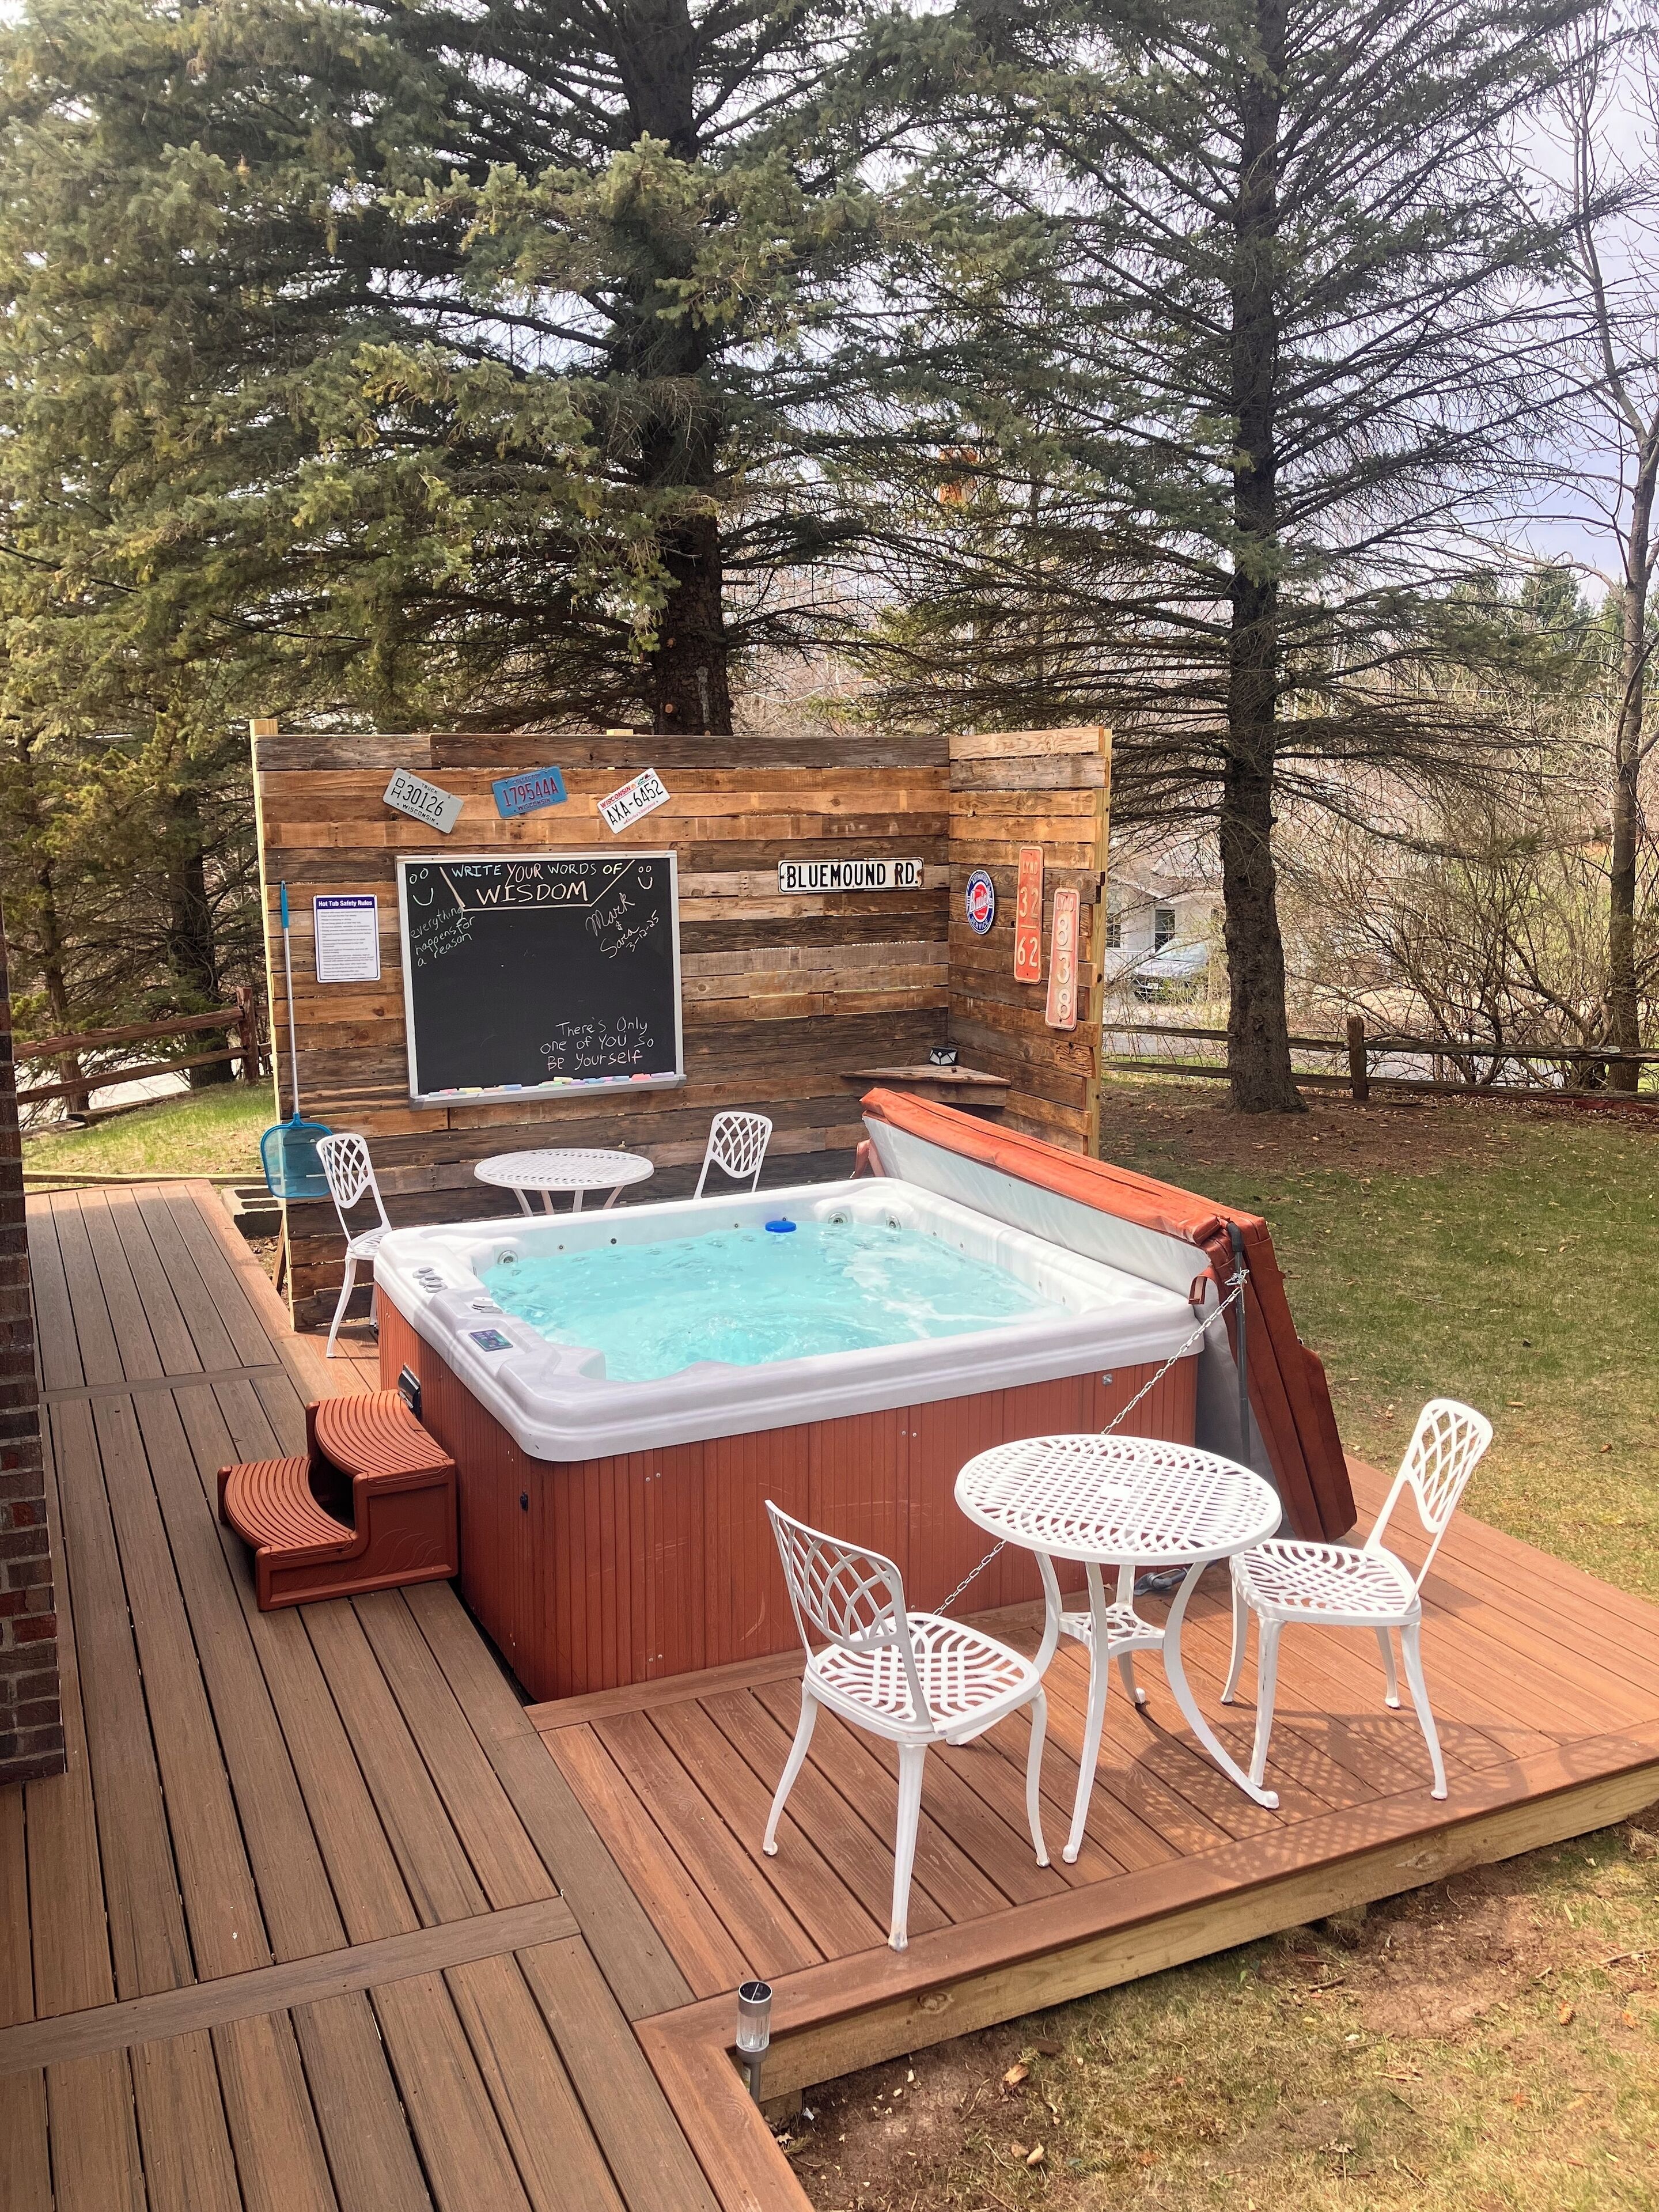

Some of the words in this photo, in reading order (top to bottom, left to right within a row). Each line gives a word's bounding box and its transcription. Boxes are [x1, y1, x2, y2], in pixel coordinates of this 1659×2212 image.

[403, 784, 444, 816] 30126
[422, 783, 437, 794] TRUCK
[503, 777, 559, 807] 179544A
[600, 785, 631, 808] WISCONSIN
[403, 803, 436, 822] WISCONSIN
[517, 798, 551, 810] WISCONSIN
[607, 779, 664, 825] AXA-6452
[452, 864, 502, 877] WRITE
[505, 863, 544, 887] YOUR
[547, 862, 597, 876] WORDS
[603, 862, 623, 875] OF
[787, 863, 886, 888] BLUEMOUND
[895, 862, 919, 885] RD.
[476, 880, 588, 906] WISDOM
[1020, 886, 1039, 919] 32
[411, 906, 464, 938] everything
[971, 916, 989, 930] SERVICE
[415, 926, 456, 956] happens
[456, 916, 475, 934] for
[418, 957, 427, 967] a
[434, 933, 472, 959] reason
[1017, 936, 1037, 967] 62
[576, 1036, 593, 1050] of
